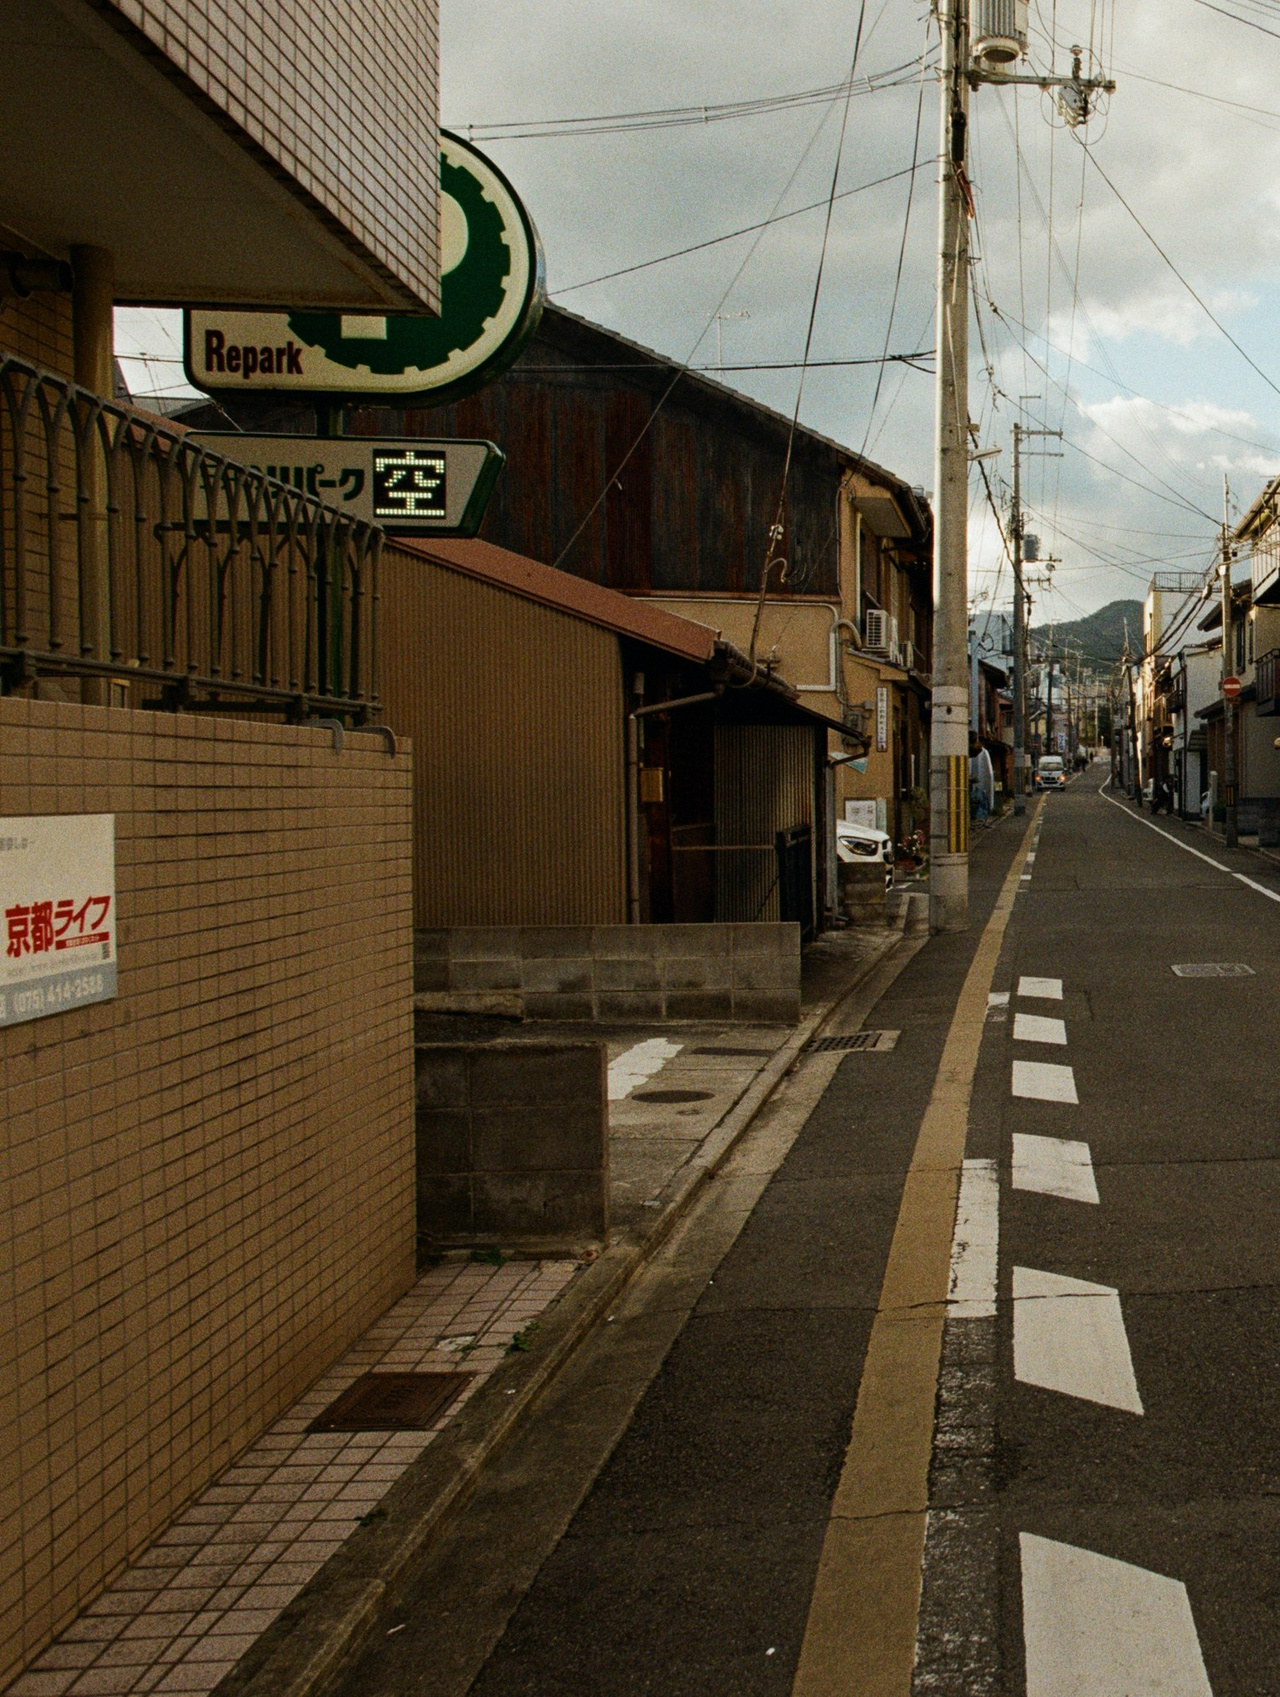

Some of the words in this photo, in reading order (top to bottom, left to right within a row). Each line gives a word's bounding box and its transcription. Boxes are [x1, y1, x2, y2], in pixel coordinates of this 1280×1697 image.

[205, 329, 303, 379] Repark
[374, 450, 445, 516] 空
[5, 896, 111, 958] 京都ライフ
